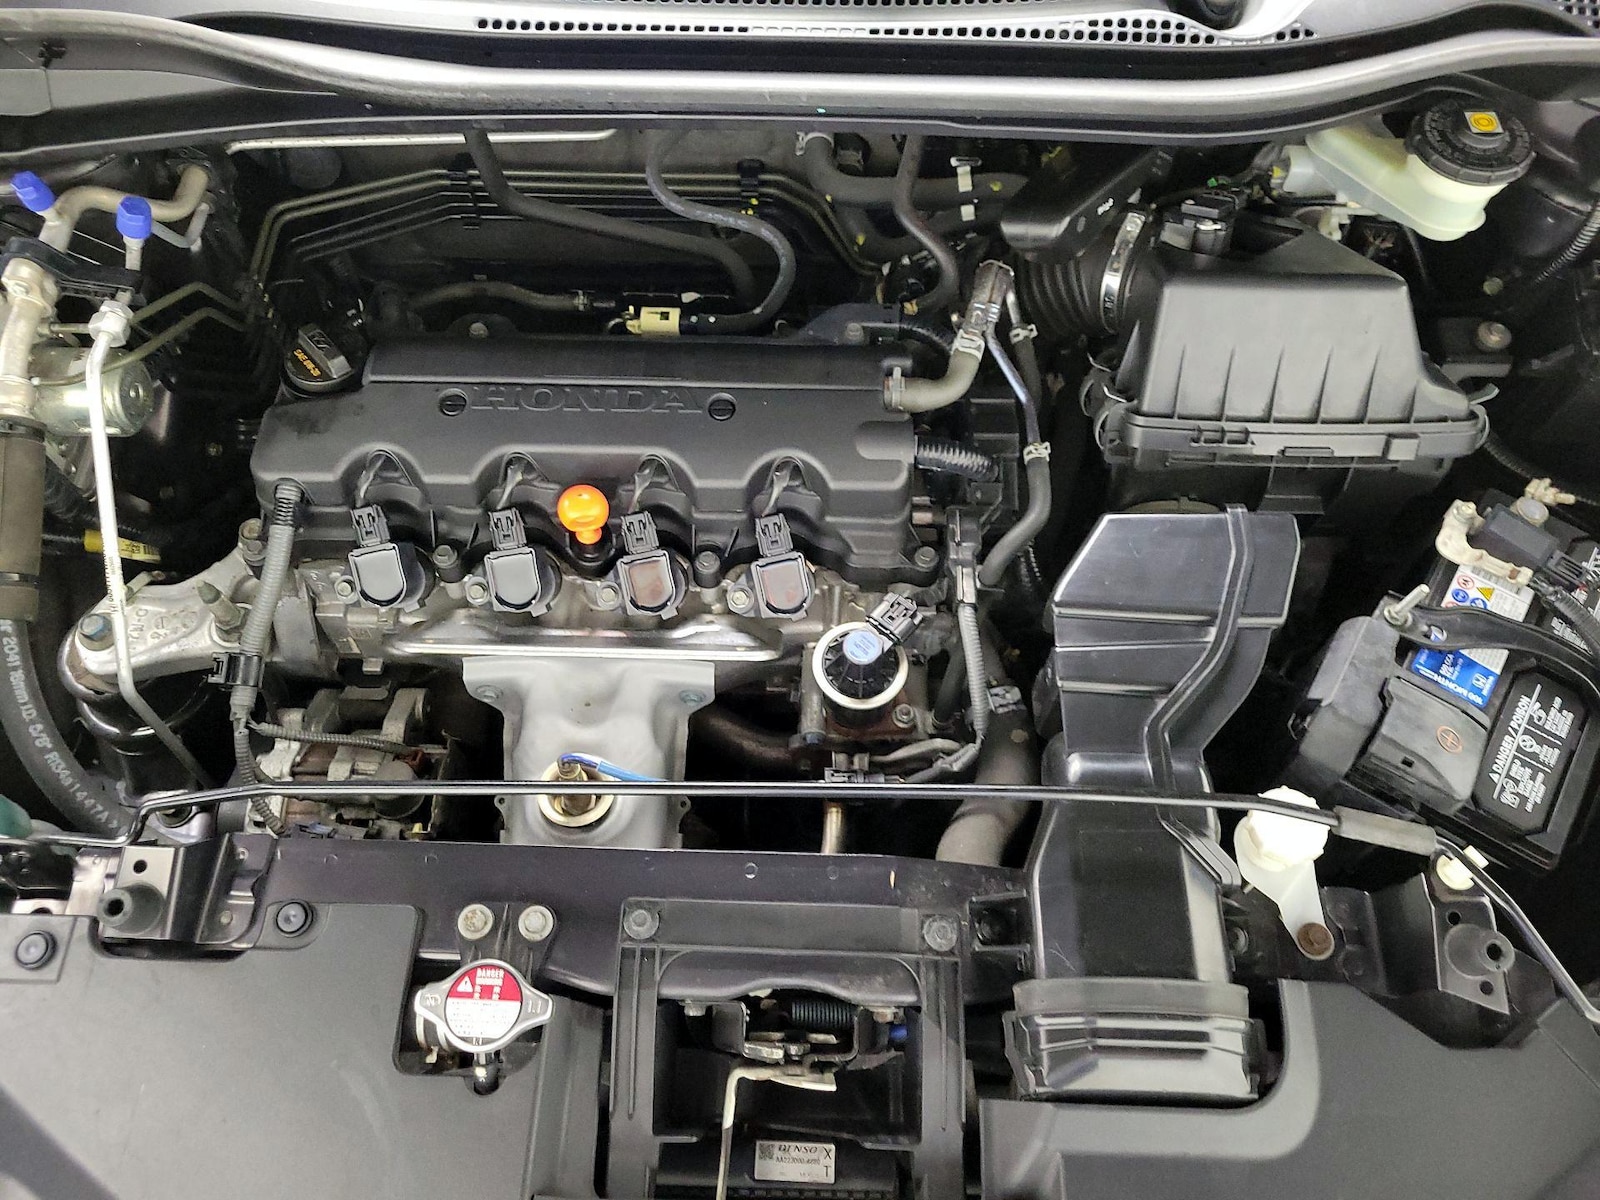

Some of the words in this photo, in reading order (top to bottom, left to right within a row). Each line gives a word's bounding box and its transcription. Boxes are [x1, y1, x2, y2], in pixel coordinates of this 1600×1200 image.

[471, 386, 702, 413] HONDA
[2, 636, 21, 667] 2041
[1490, 734, 1514, 773] DANGER
[1509, 694, 1531, 729] POISON
[476, 967, 504, 978] DANGER
[823, 1146, 832, 1160] X
[823, 1165, 831, 1177] T
